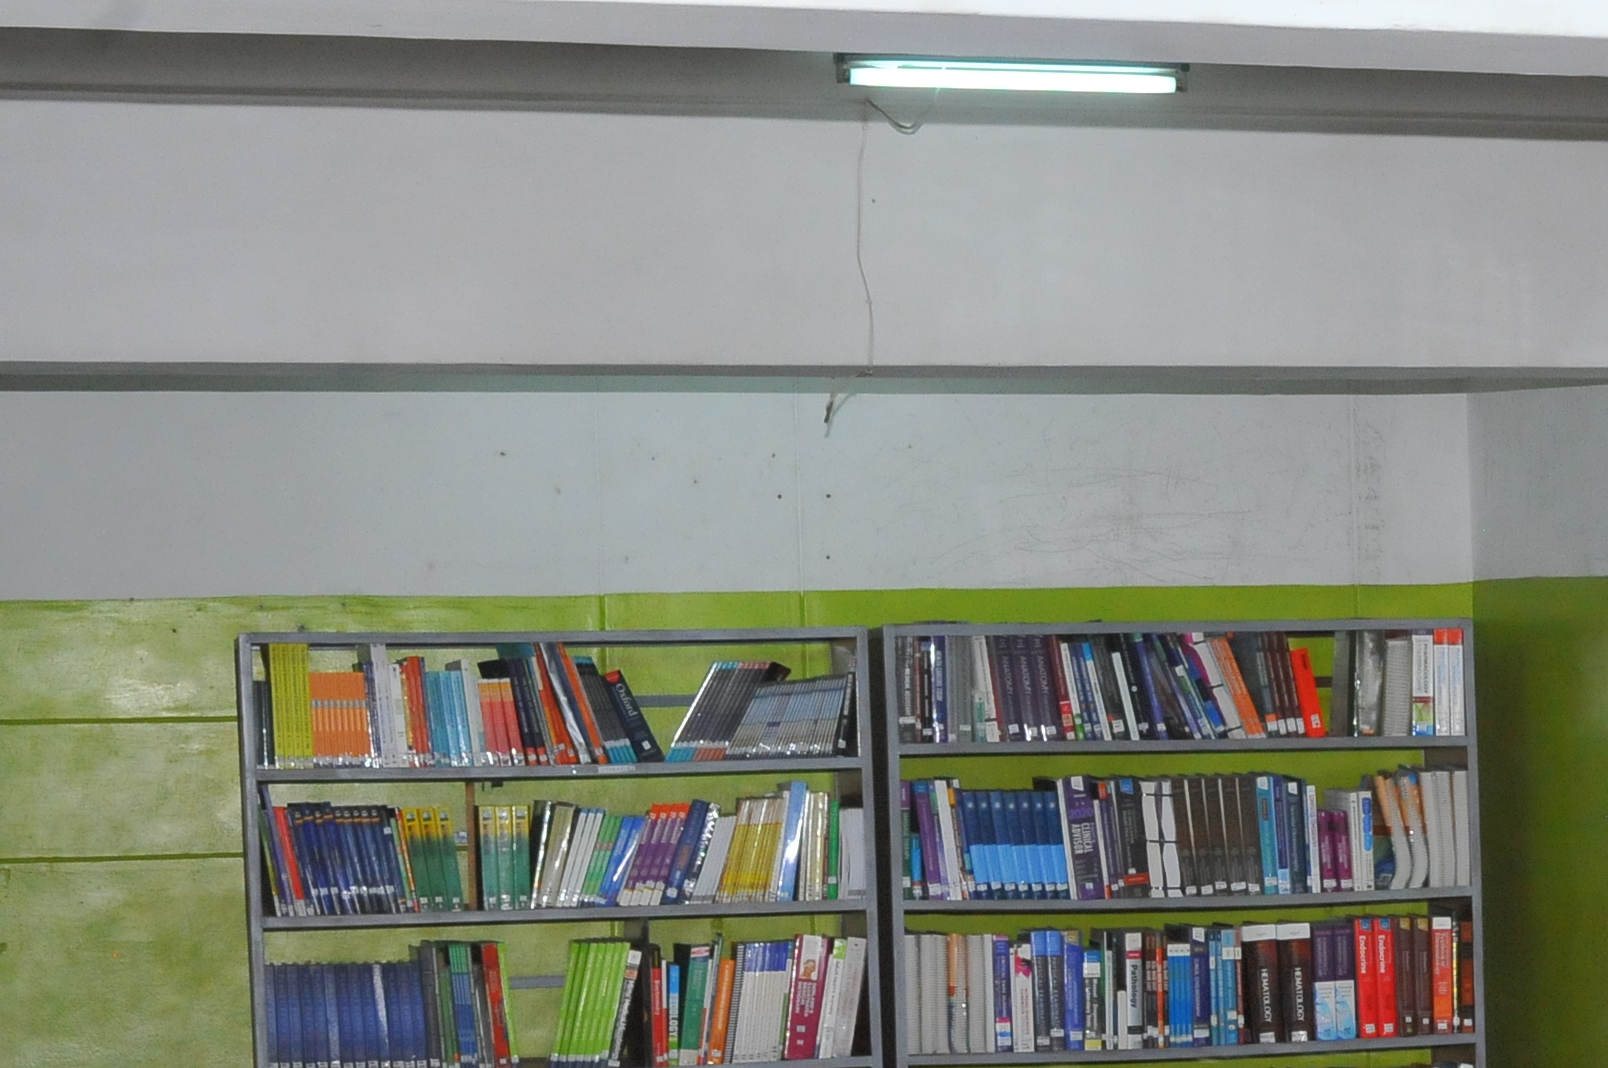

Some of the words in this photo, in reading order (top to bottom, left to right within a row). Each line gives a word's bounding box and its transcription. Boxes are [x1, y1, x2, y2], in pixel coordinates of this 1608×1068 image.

[1002, 655, 1013, 696] ANATOMY
[1019, 656, 1032, 695] ANATOMY
[1037, 655, 1049, 695] ANATOMY
[616, 683, 637, 717] Oxford
[1071, 823, 1084, 855] ADVISOR
[1081, 822, 1094, 853] CLINICAL
[1036, 957, 1044, 986] PHYSICAL
[1359, 935, 1367, 974] Endocrine
[1378, 934, 1386, 974] Endocrine
[1130, 964, 1138, 1009] Pathology
[1260, 969, 1272, 1023] HEMATOLOGY
[1293, 967, 1305, 1021] HEMATOLOGY
